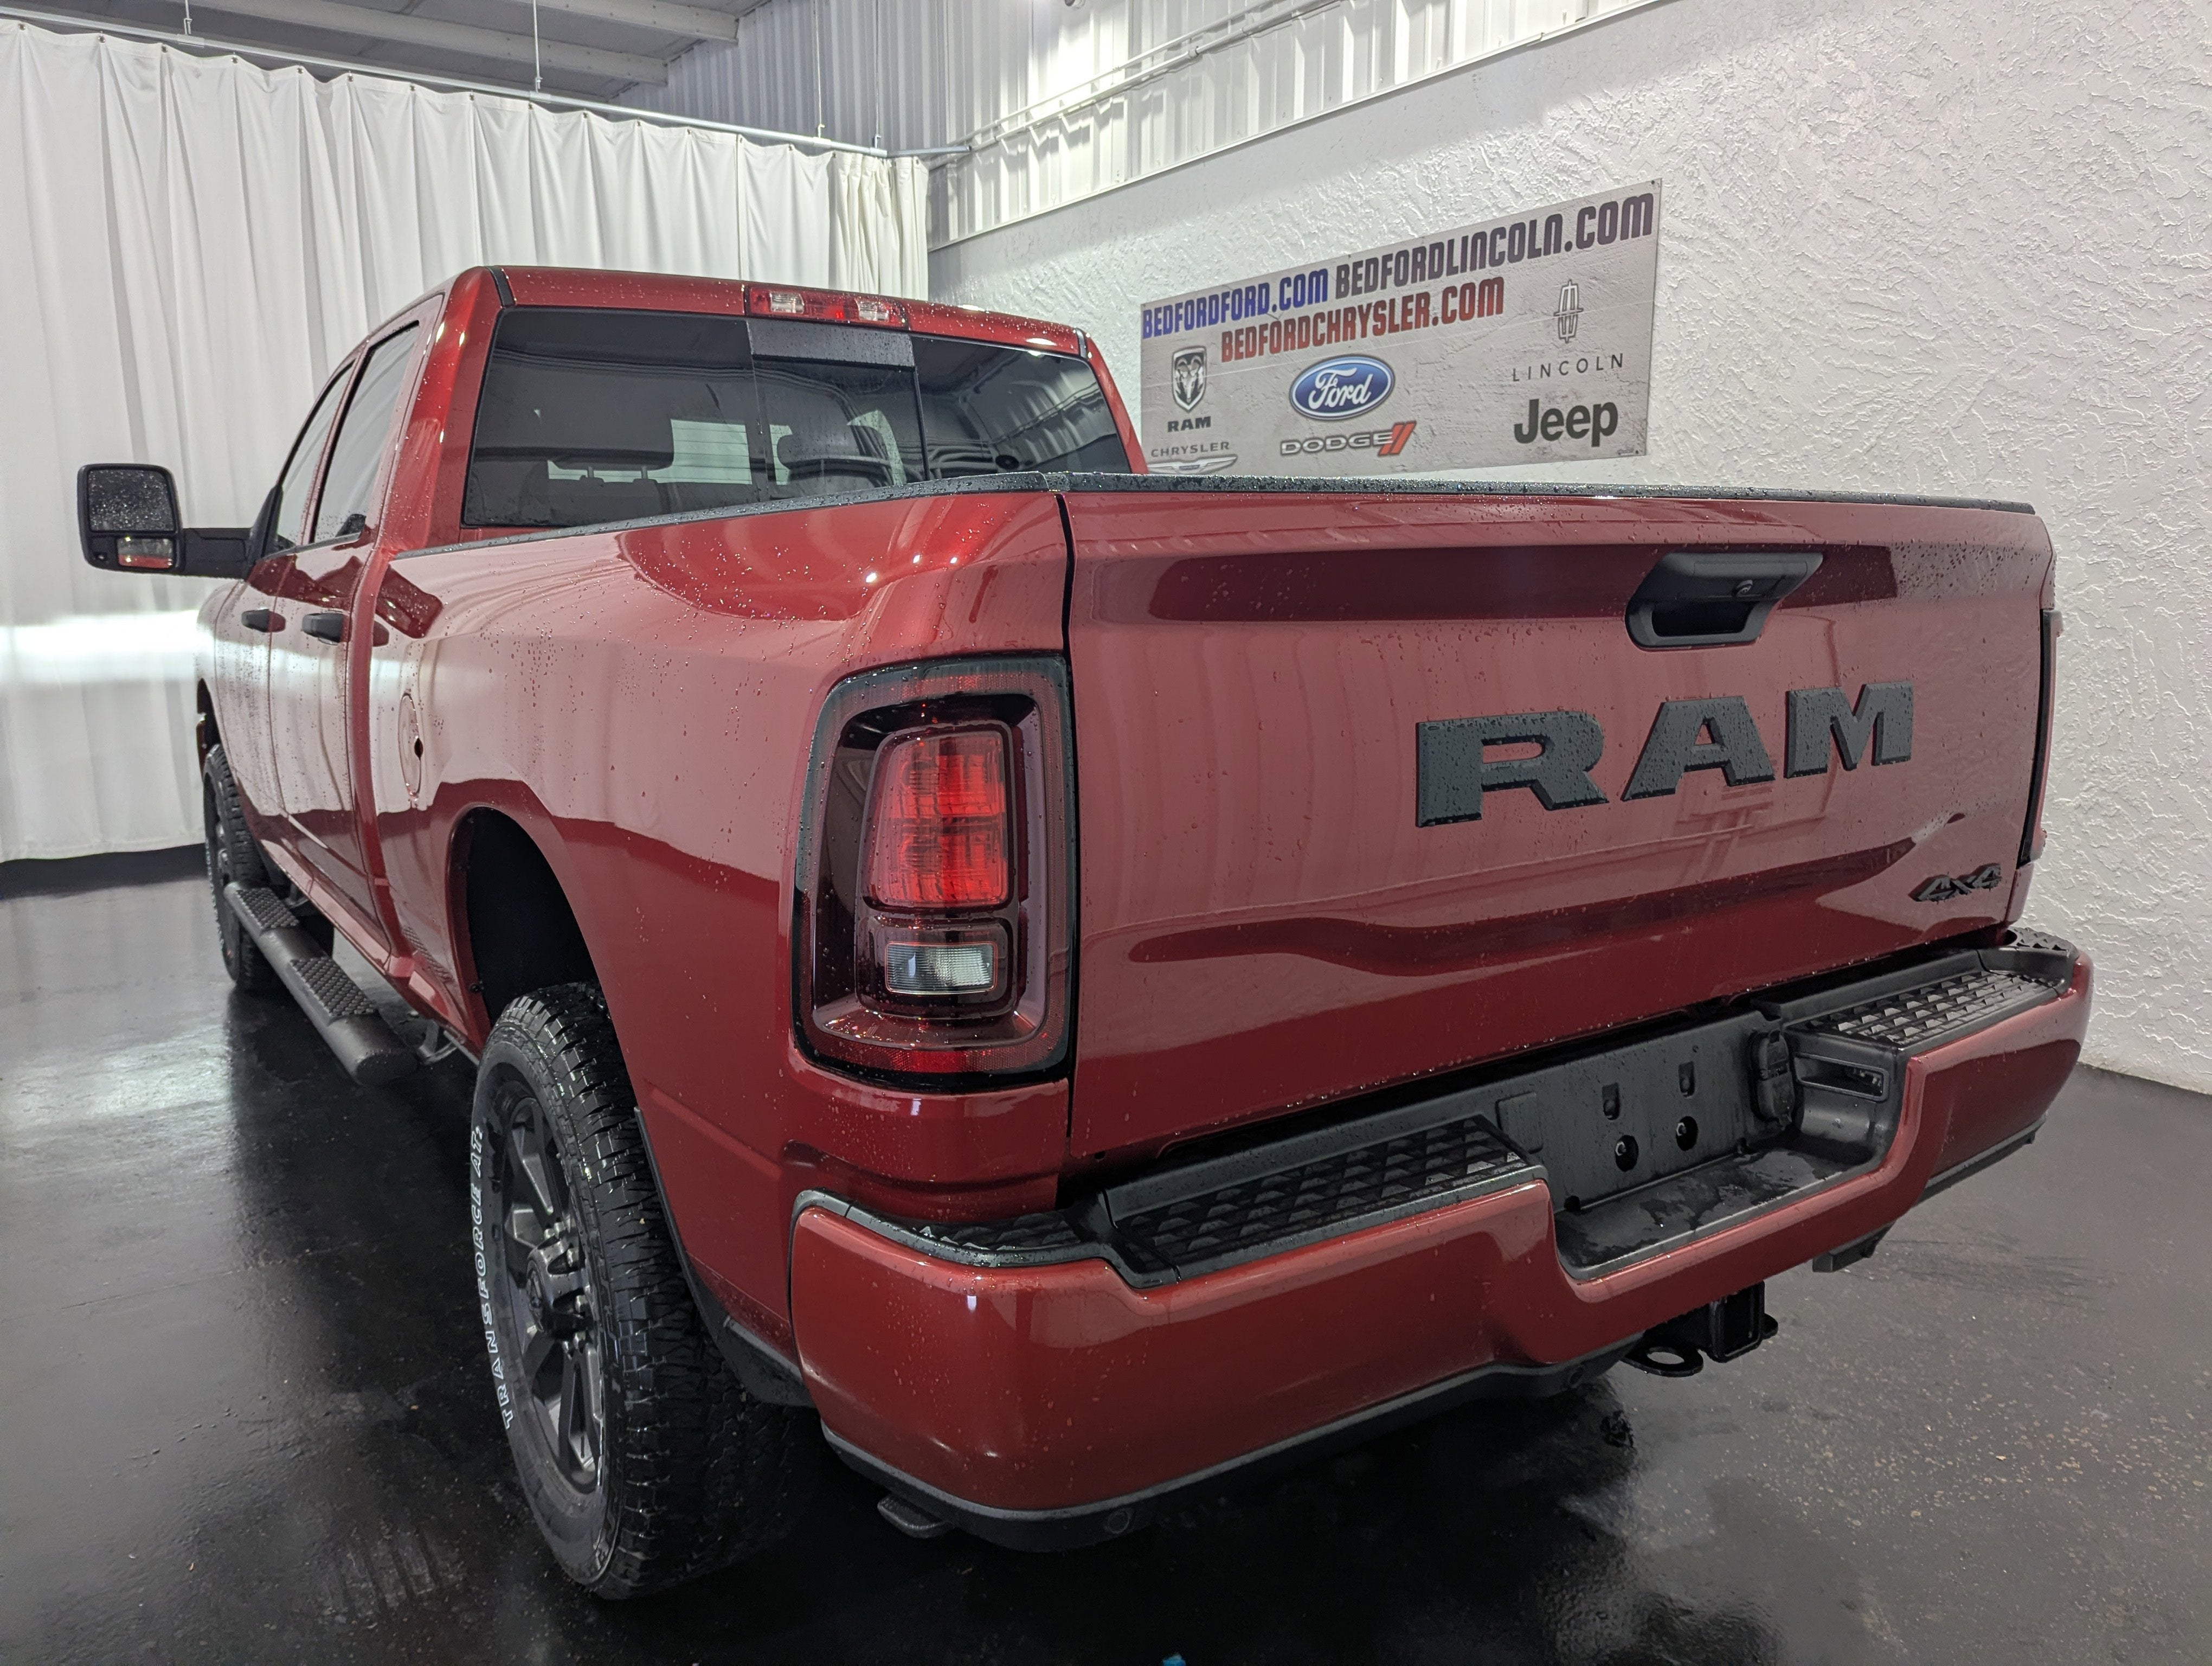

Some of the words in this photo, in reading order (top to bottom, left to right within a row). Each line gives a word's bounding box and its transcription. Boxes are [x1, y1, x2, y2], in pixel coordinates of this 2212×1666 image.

[1142, 268, 1328, 339] BEDFORDFORD.COM
[1335, 193, 1654, 299] BEDFORDLINCOLN.COM
[1221, 277, 1504, 363] BEDFORDCHRYSLER.COM
[1308, 367, 1373, 409] Ford
[1513, 353, 1623, 382] LINCOLN
[1167, 415, 1211, 432] RAM
[1280, 431, 1394, 456] DODGE
[1514, 399, 1618, 447] Jeep
[1151, 441, 1230, 457] CHRYSLER
[1414, 680, 1914, 828] RAM
[471, 1183, 514, 1430] TRANSFORCE
